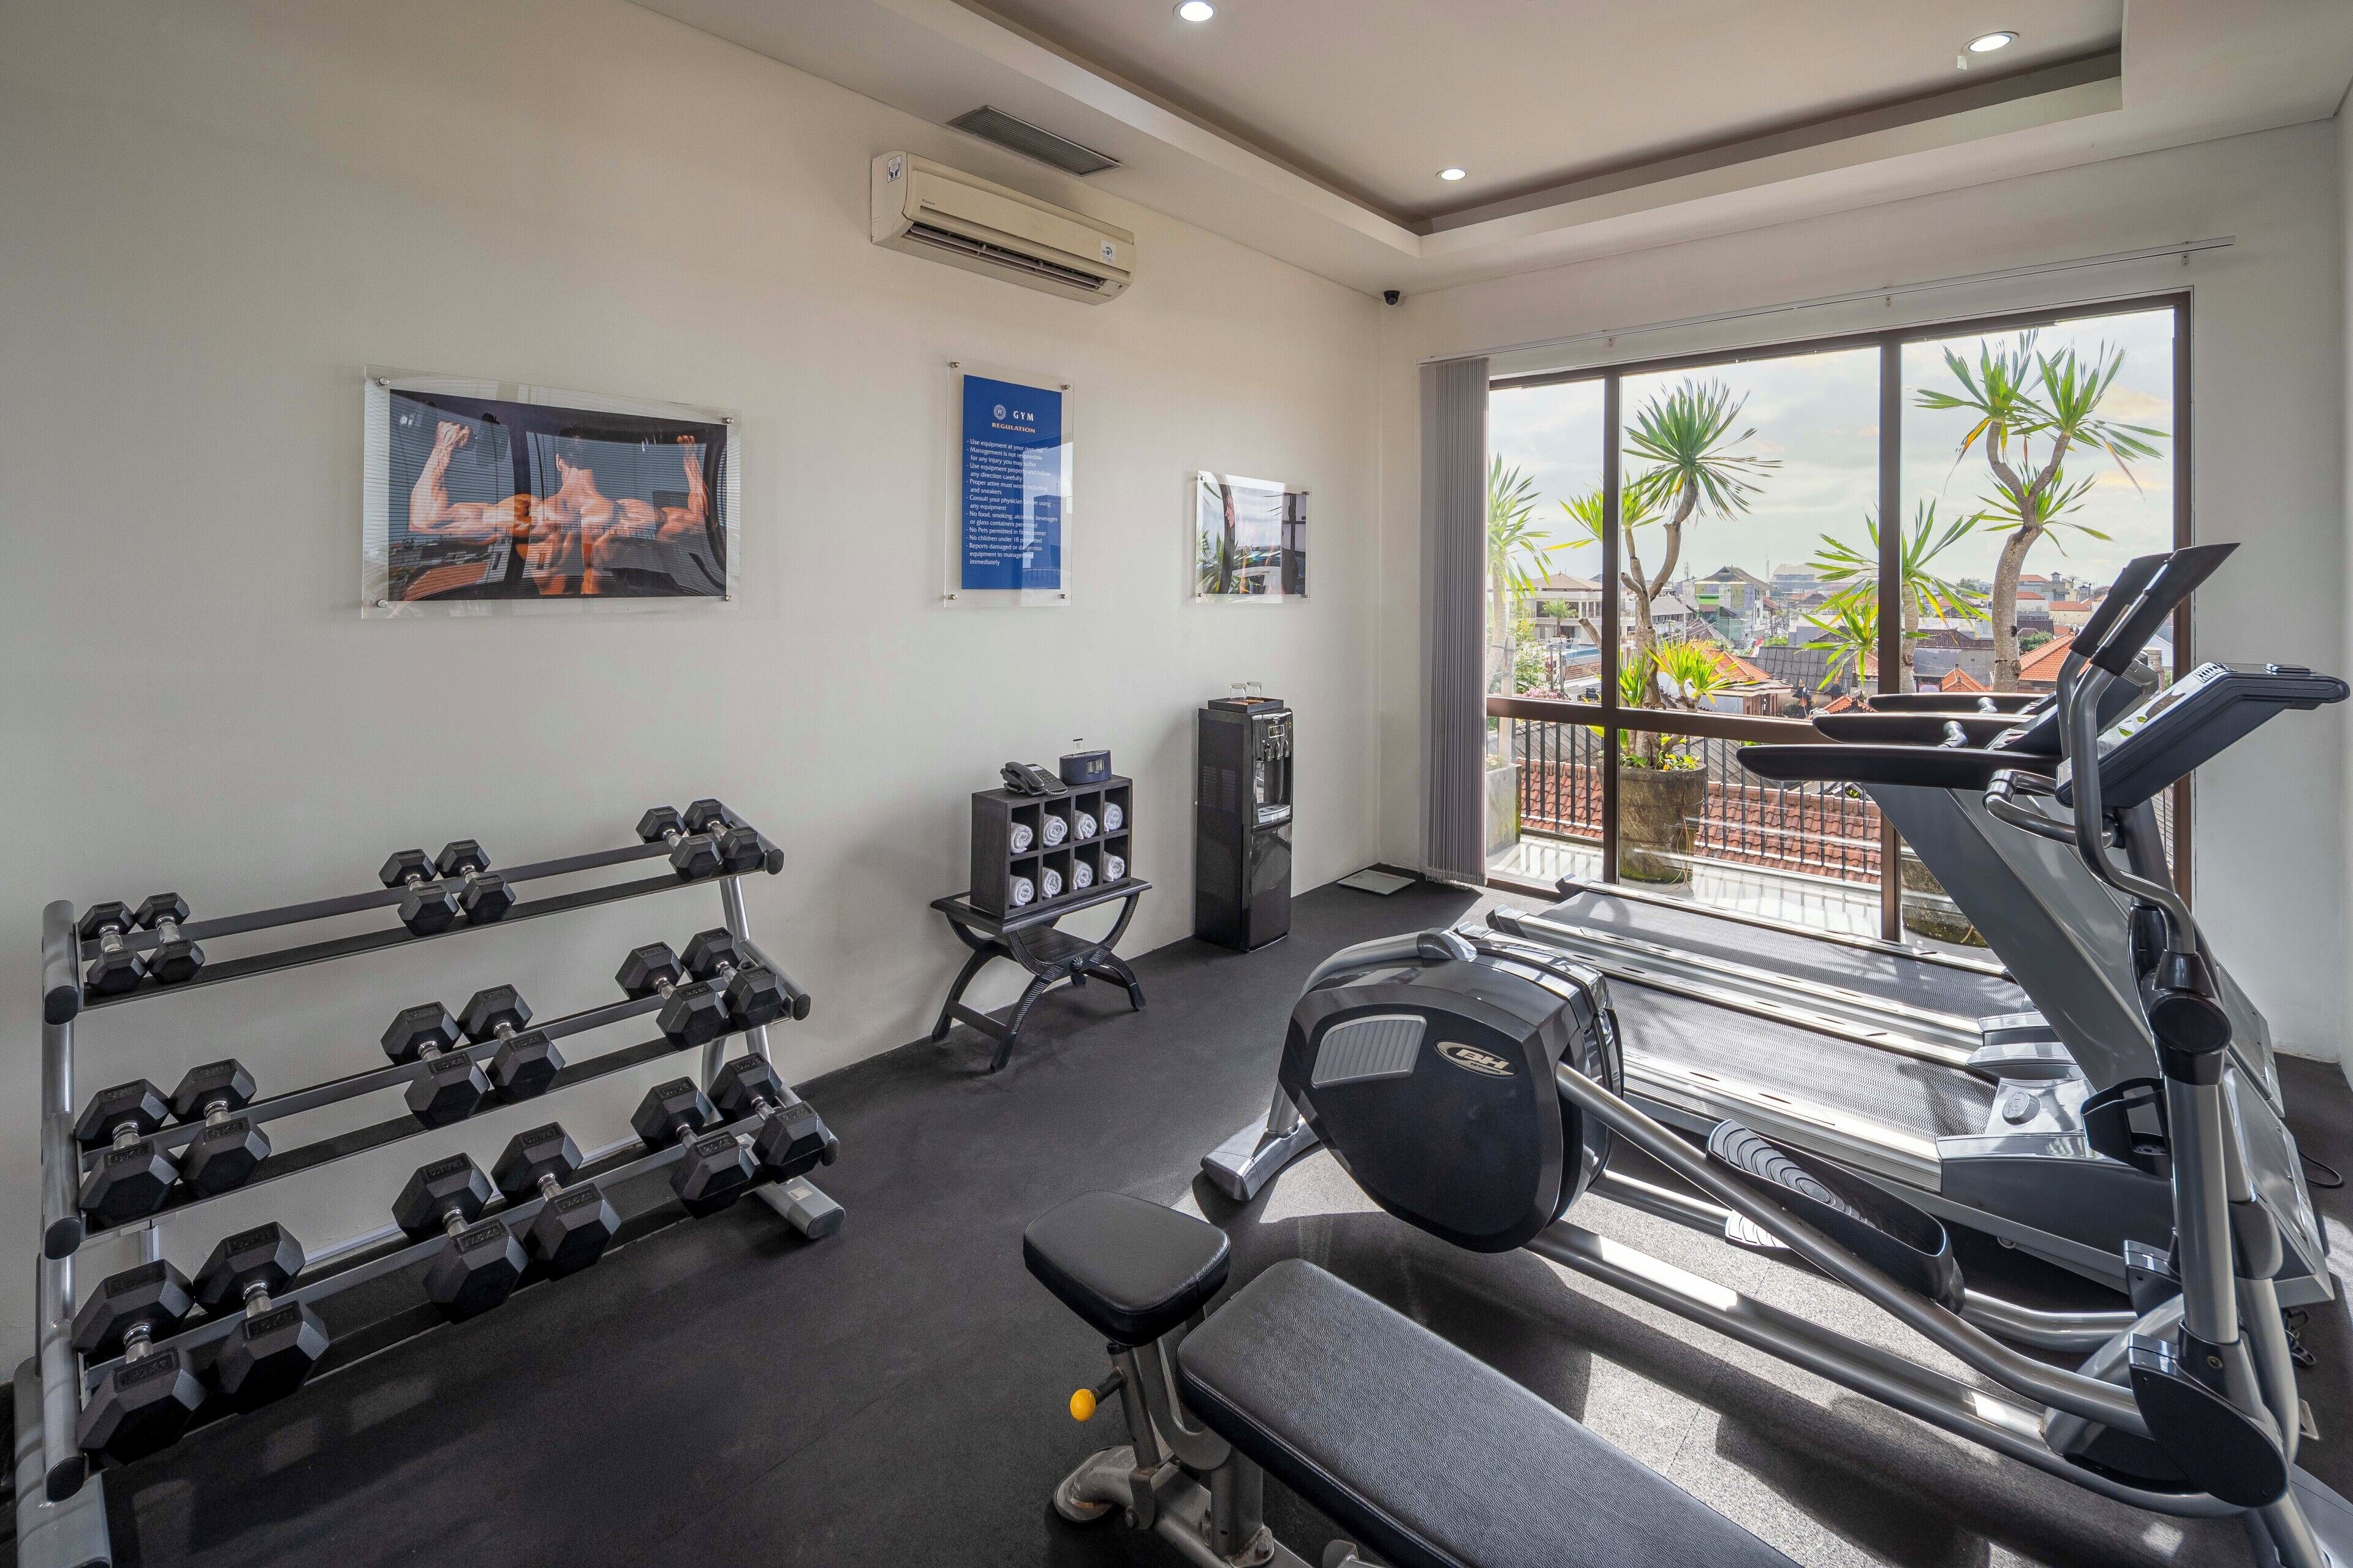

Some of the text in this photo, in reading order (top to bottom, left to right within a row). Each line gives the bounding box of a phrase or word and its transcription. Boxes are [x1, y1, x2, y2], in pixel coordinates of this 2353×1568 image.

[1013, 411, 1034, 422] GYM
[991, 422, 1036, 433] REGULATION
[970, 446, 1002, 456] Management
[1017, 453, 1043, 461] responsible
[1455, 1048, 1509, 1069] BH
